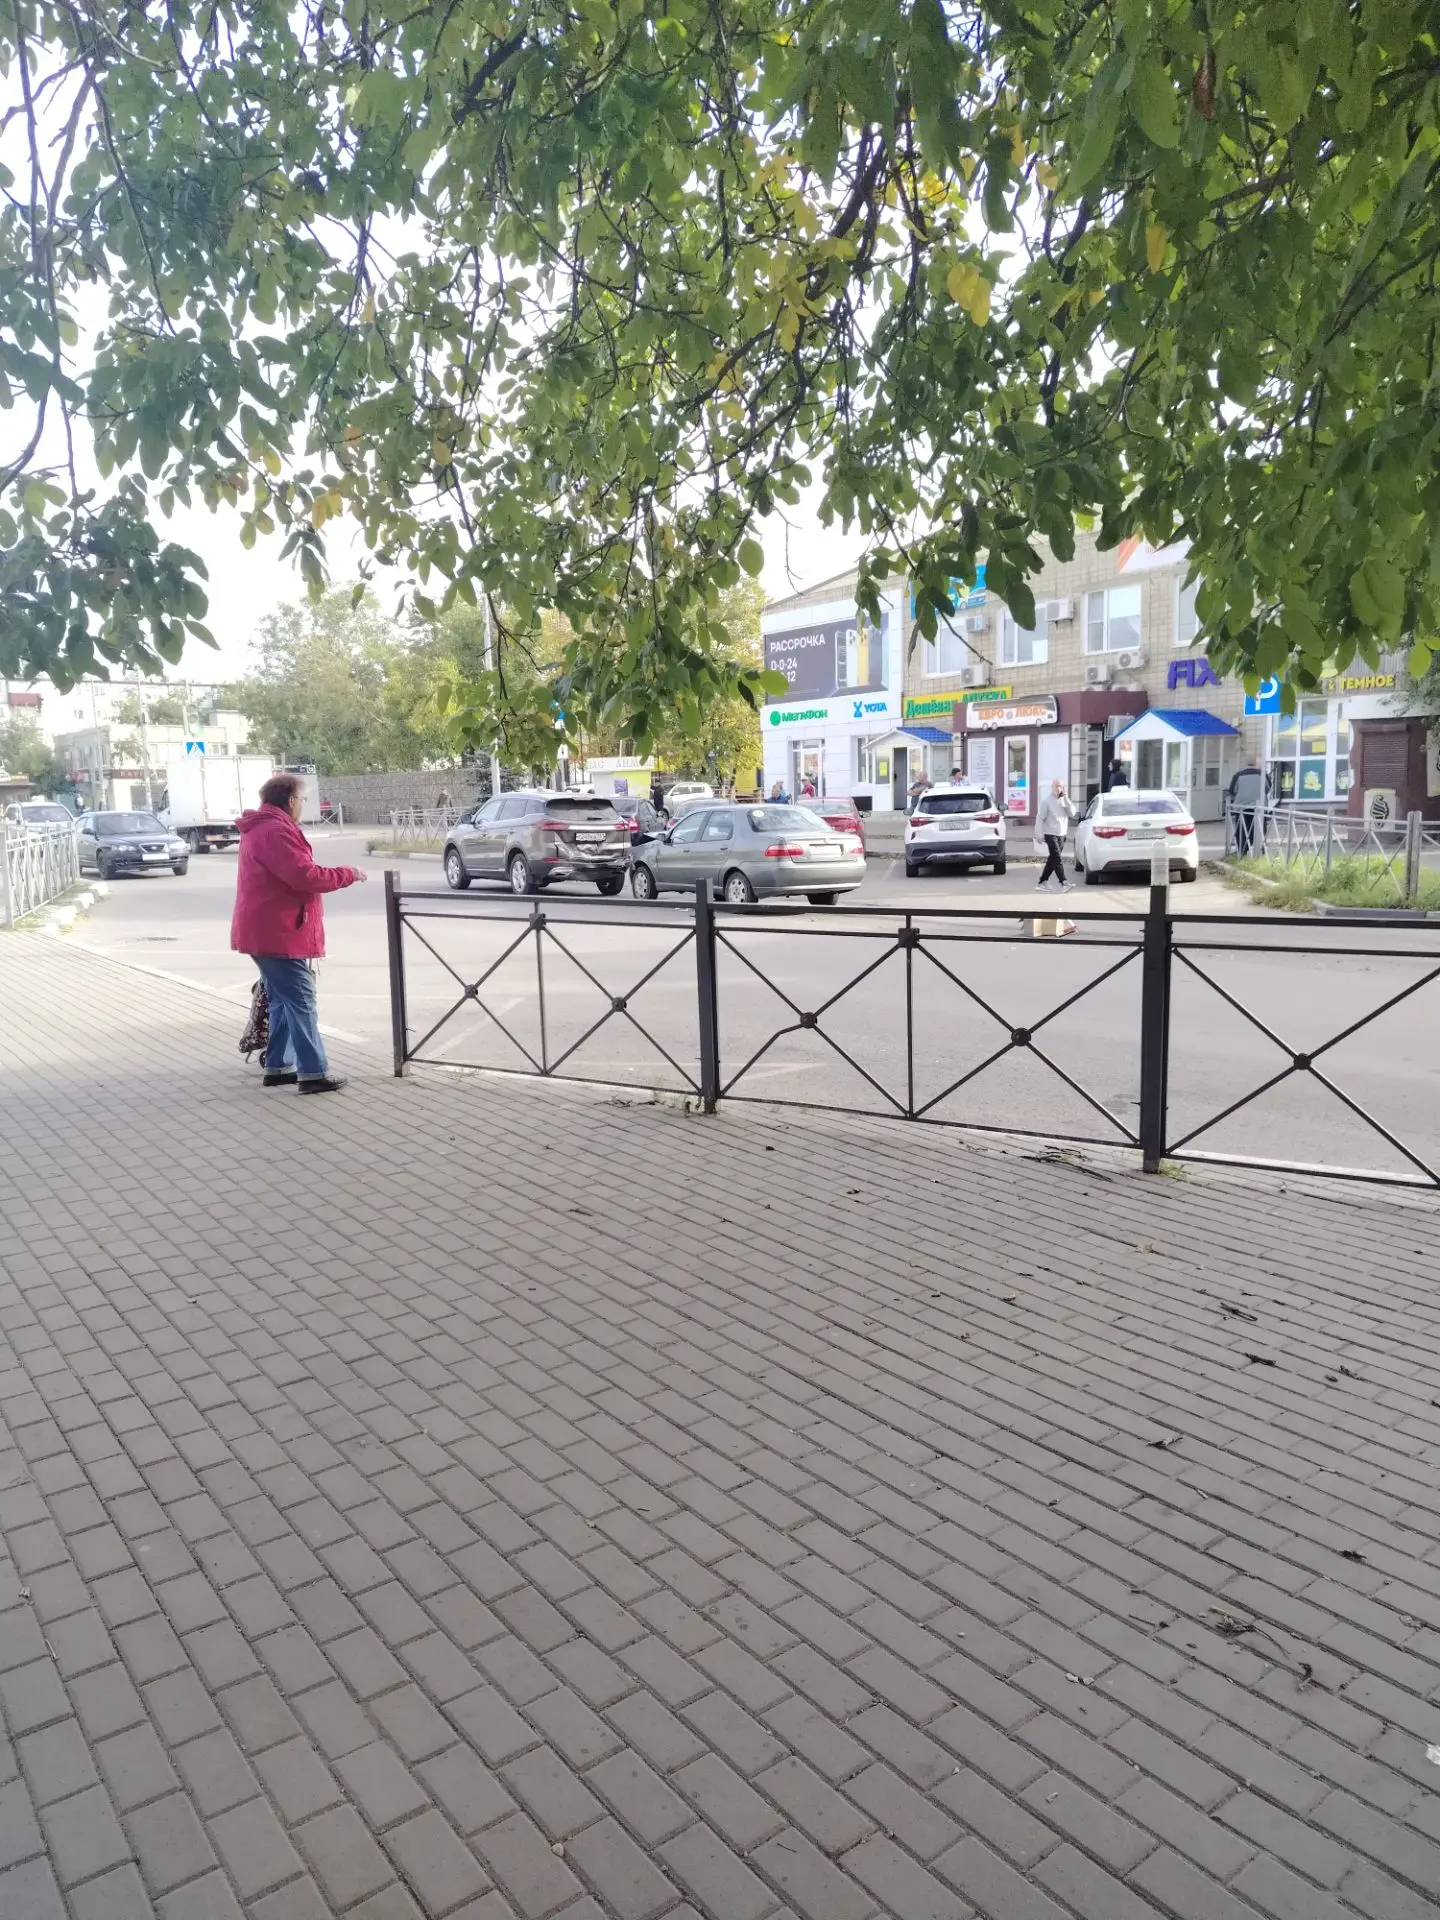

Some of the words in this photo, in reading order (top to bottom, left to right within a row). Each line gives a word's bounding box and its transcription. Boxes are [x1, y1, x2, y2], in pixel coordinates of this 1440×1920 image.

[770, 634, 826, 653] РАССРОЧКА
[1340, 675, 1394, 690] ТЕМНОЕ
[864, 702, 888, 714] YOTA
